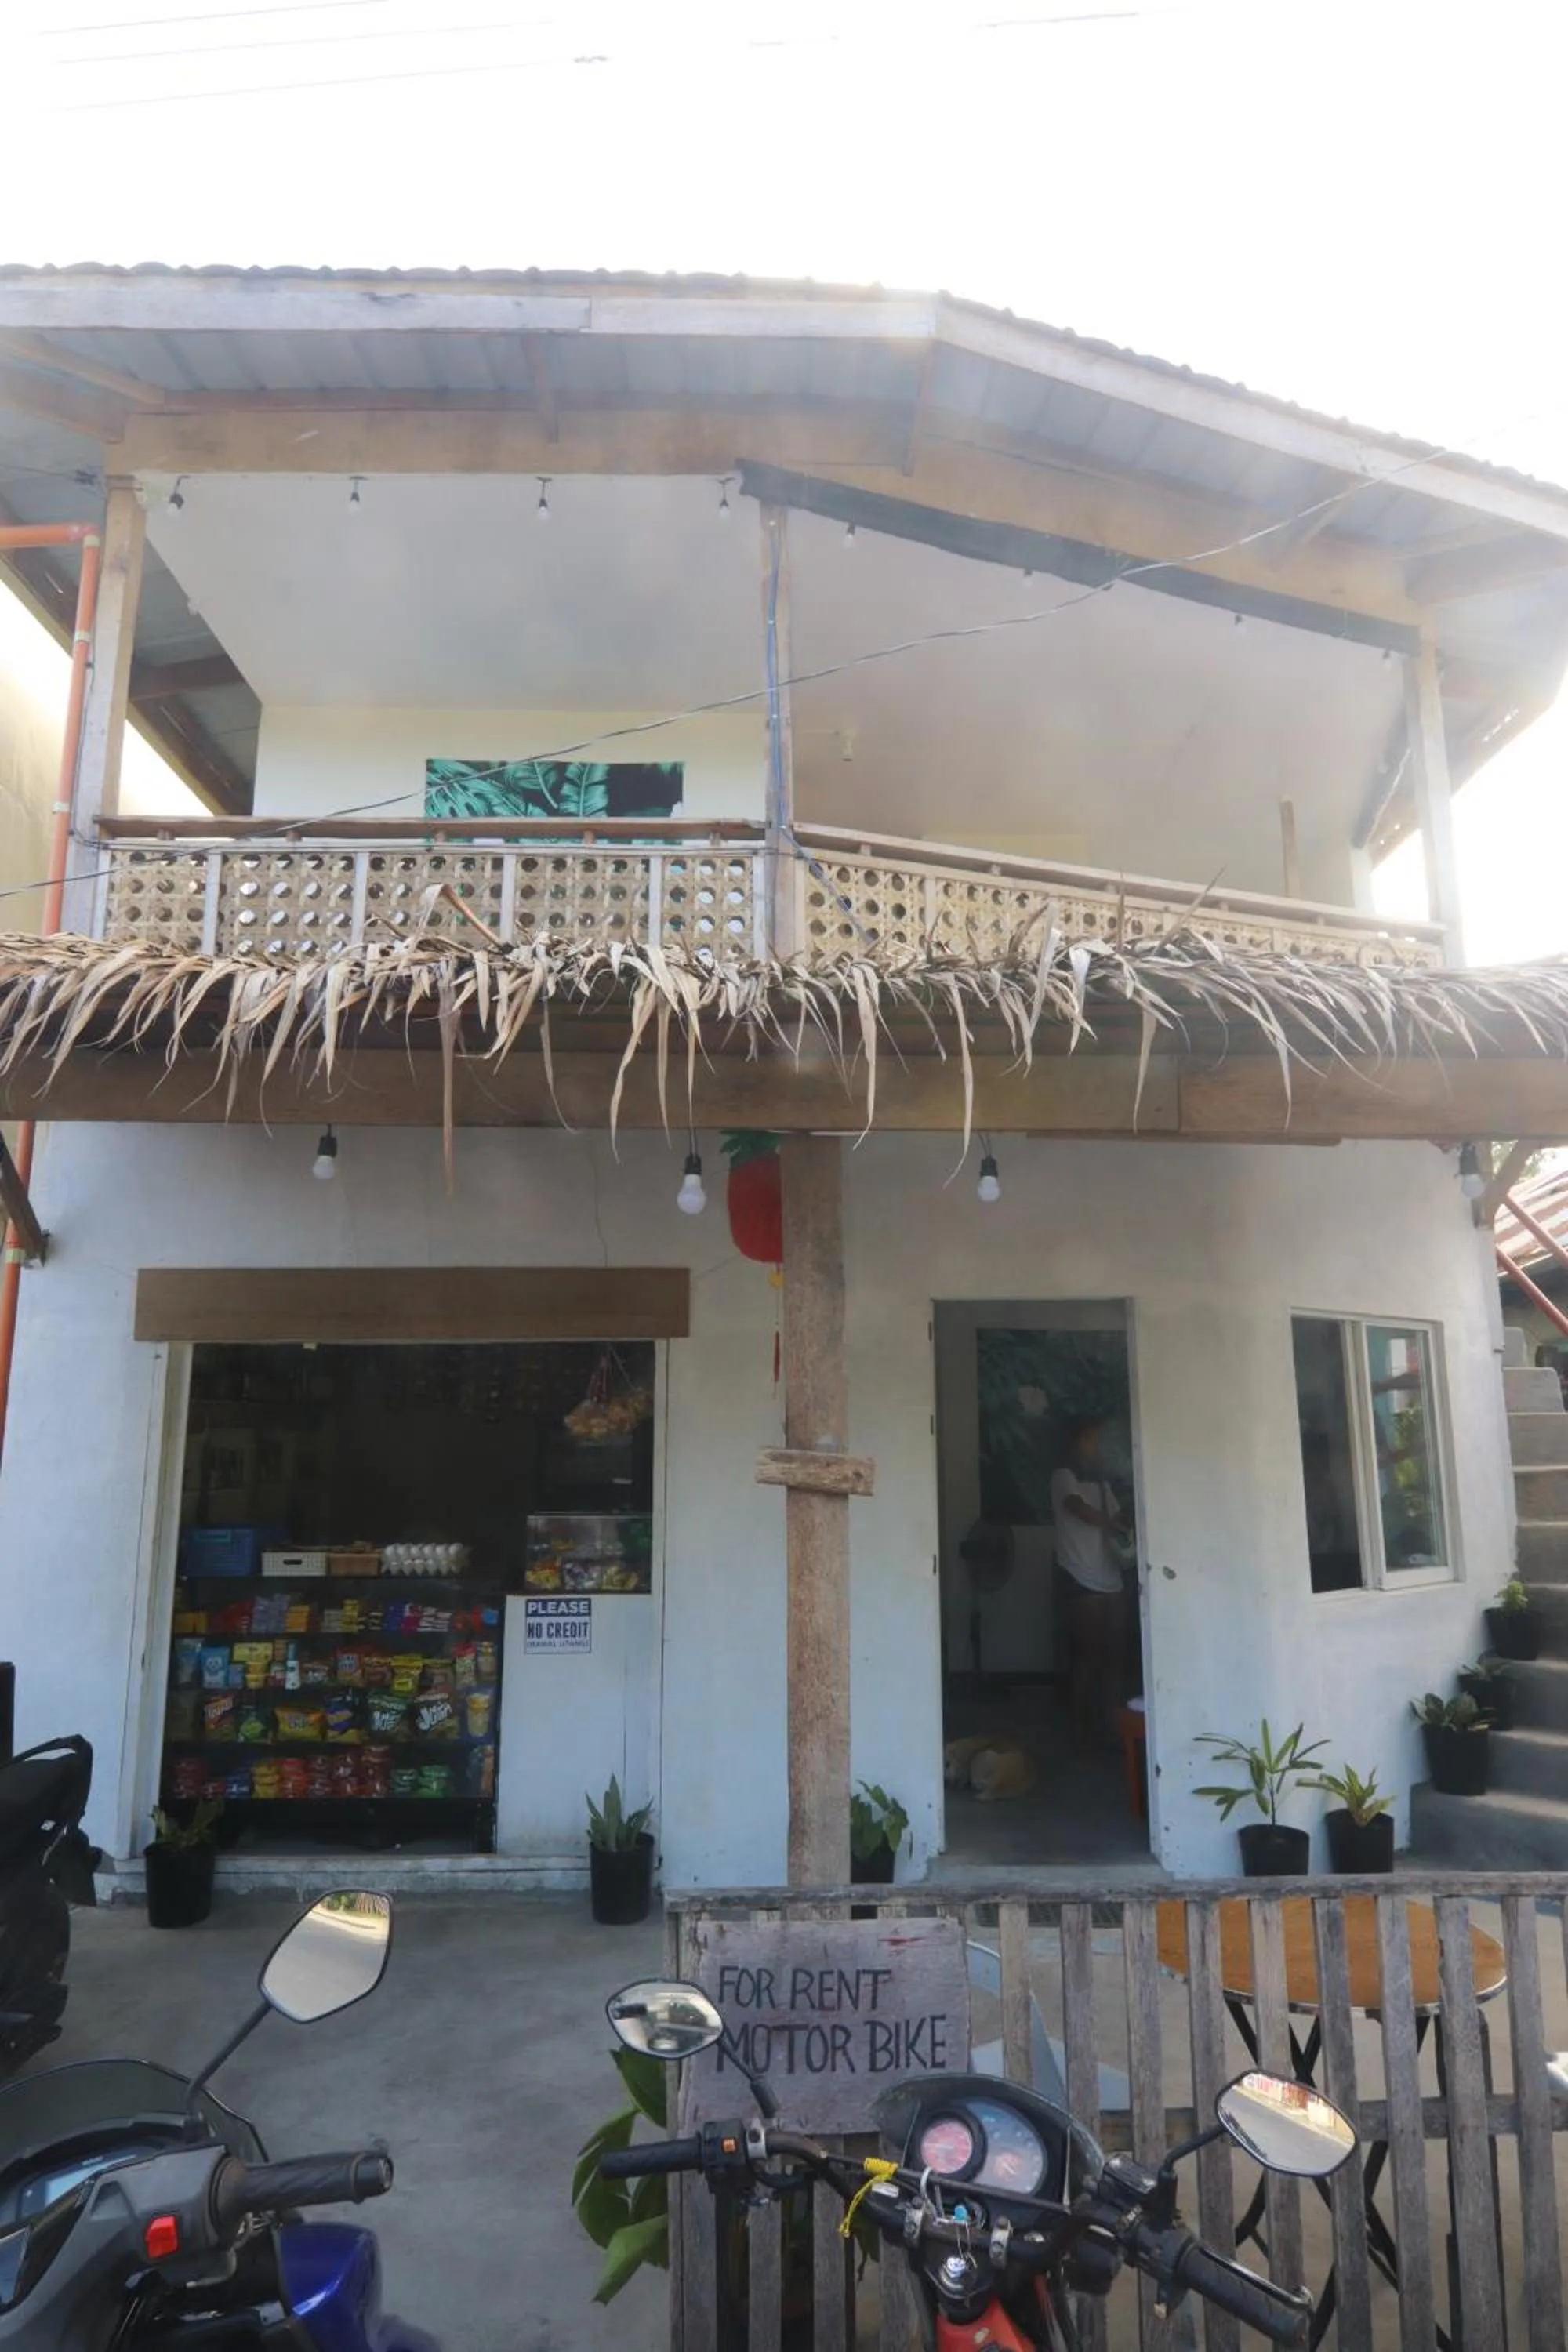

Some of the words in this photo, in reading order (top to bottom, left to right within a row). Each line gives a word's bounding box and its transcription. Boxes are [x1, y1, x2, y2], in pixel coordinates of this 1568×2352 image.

[528, 1601, 590, 1614] PLEASE
[528, 1622, 543, 1639] NO
[547, 1622, 590, 1639] CREDIT
[718, 1965, 776, 2009] FOR
[790, 1969, 892, 2012] RENT
[717, 2021, 856, 2074] MOTOR
[863, 2014, 947, 2073] BIKE
